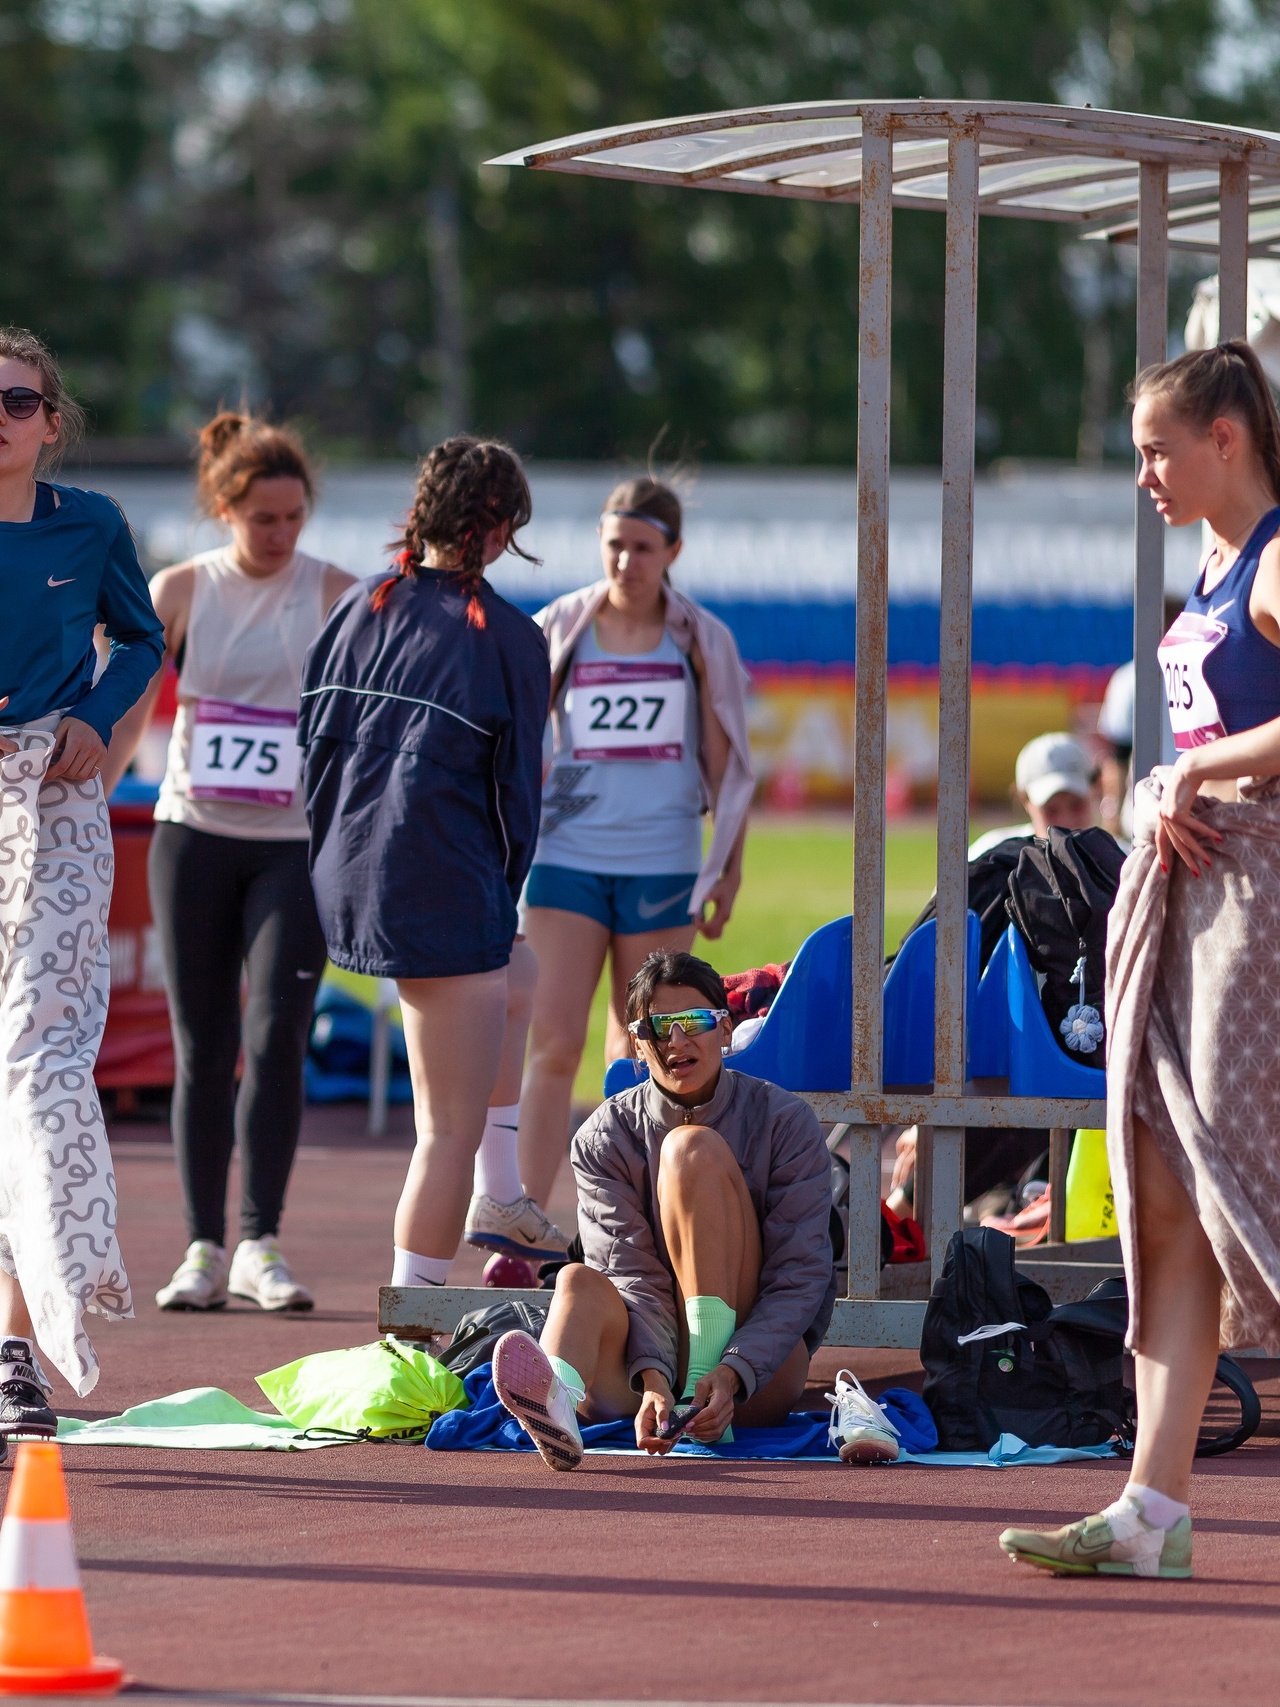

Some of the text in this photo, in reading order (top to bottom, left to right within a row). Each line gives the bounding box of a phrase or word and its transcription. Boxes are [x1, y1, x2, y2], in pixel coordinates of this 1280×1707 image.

[1165, 662, 1194, 710] 205
[589, 696, 666, 731] 227
[206, 735, 281, 775] 175
